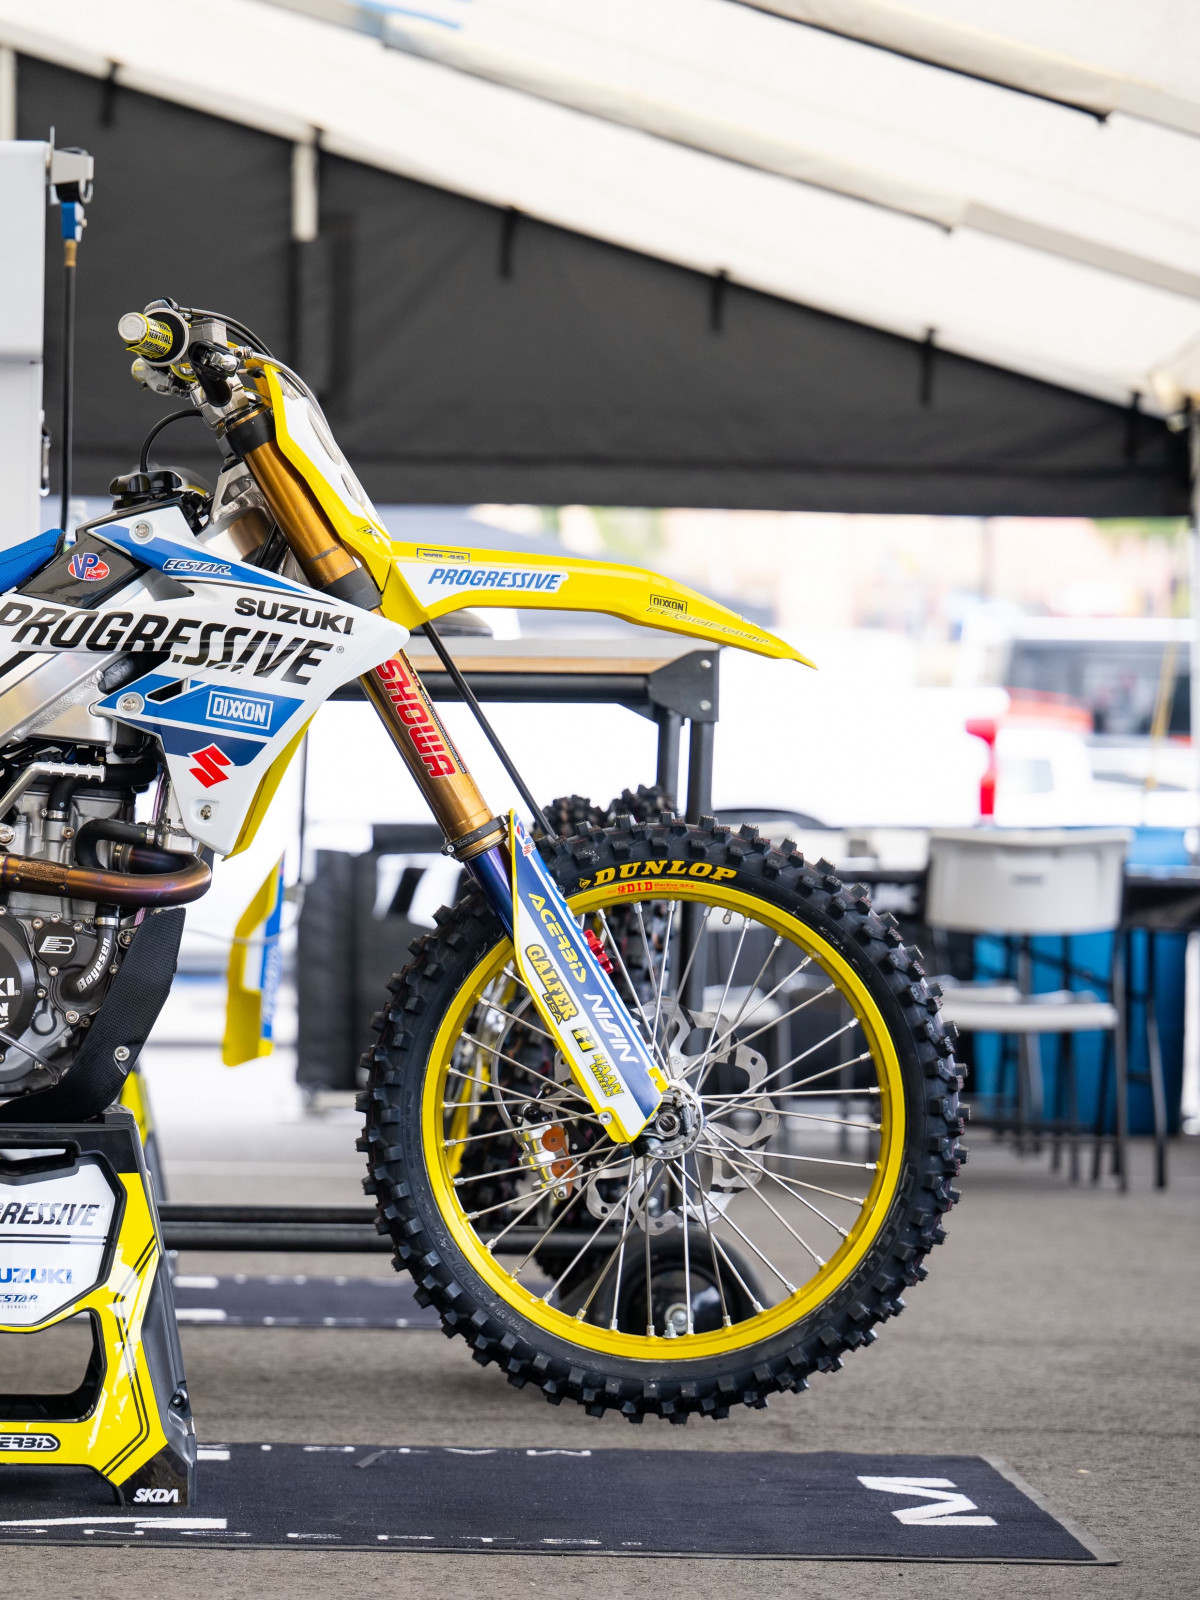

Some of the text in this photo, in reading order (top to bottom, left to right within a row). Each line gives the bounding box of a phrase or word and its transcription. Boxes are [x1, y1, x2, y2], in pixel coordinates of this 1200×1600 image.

[72, 553, 99, 579] VP
[162, 558, 232, 576] ECSTAR
[428, 568, 562, 590] PROGRESSIVE
[235, 597, 354, 635] SUZUKI
[654, 597, 684, 611] DIXXON
[213, 696, 267, 723] DIXXON
[376, 658, 456, 779] SHOWA
[593, 860, 738, 887] DUNLOP
[528, 893, 587, 983] ACERBIS
[525, 944, 580, 1021] GALFER
[543, 994, 563, 1026] USA
[584, 993, 639, 1063] NISSIN
[590, 1063, 613, 1097] WHEELS
[592, 1053, 624, 1095] HAAN
[133, 1488, 179, 1503] SKDA
